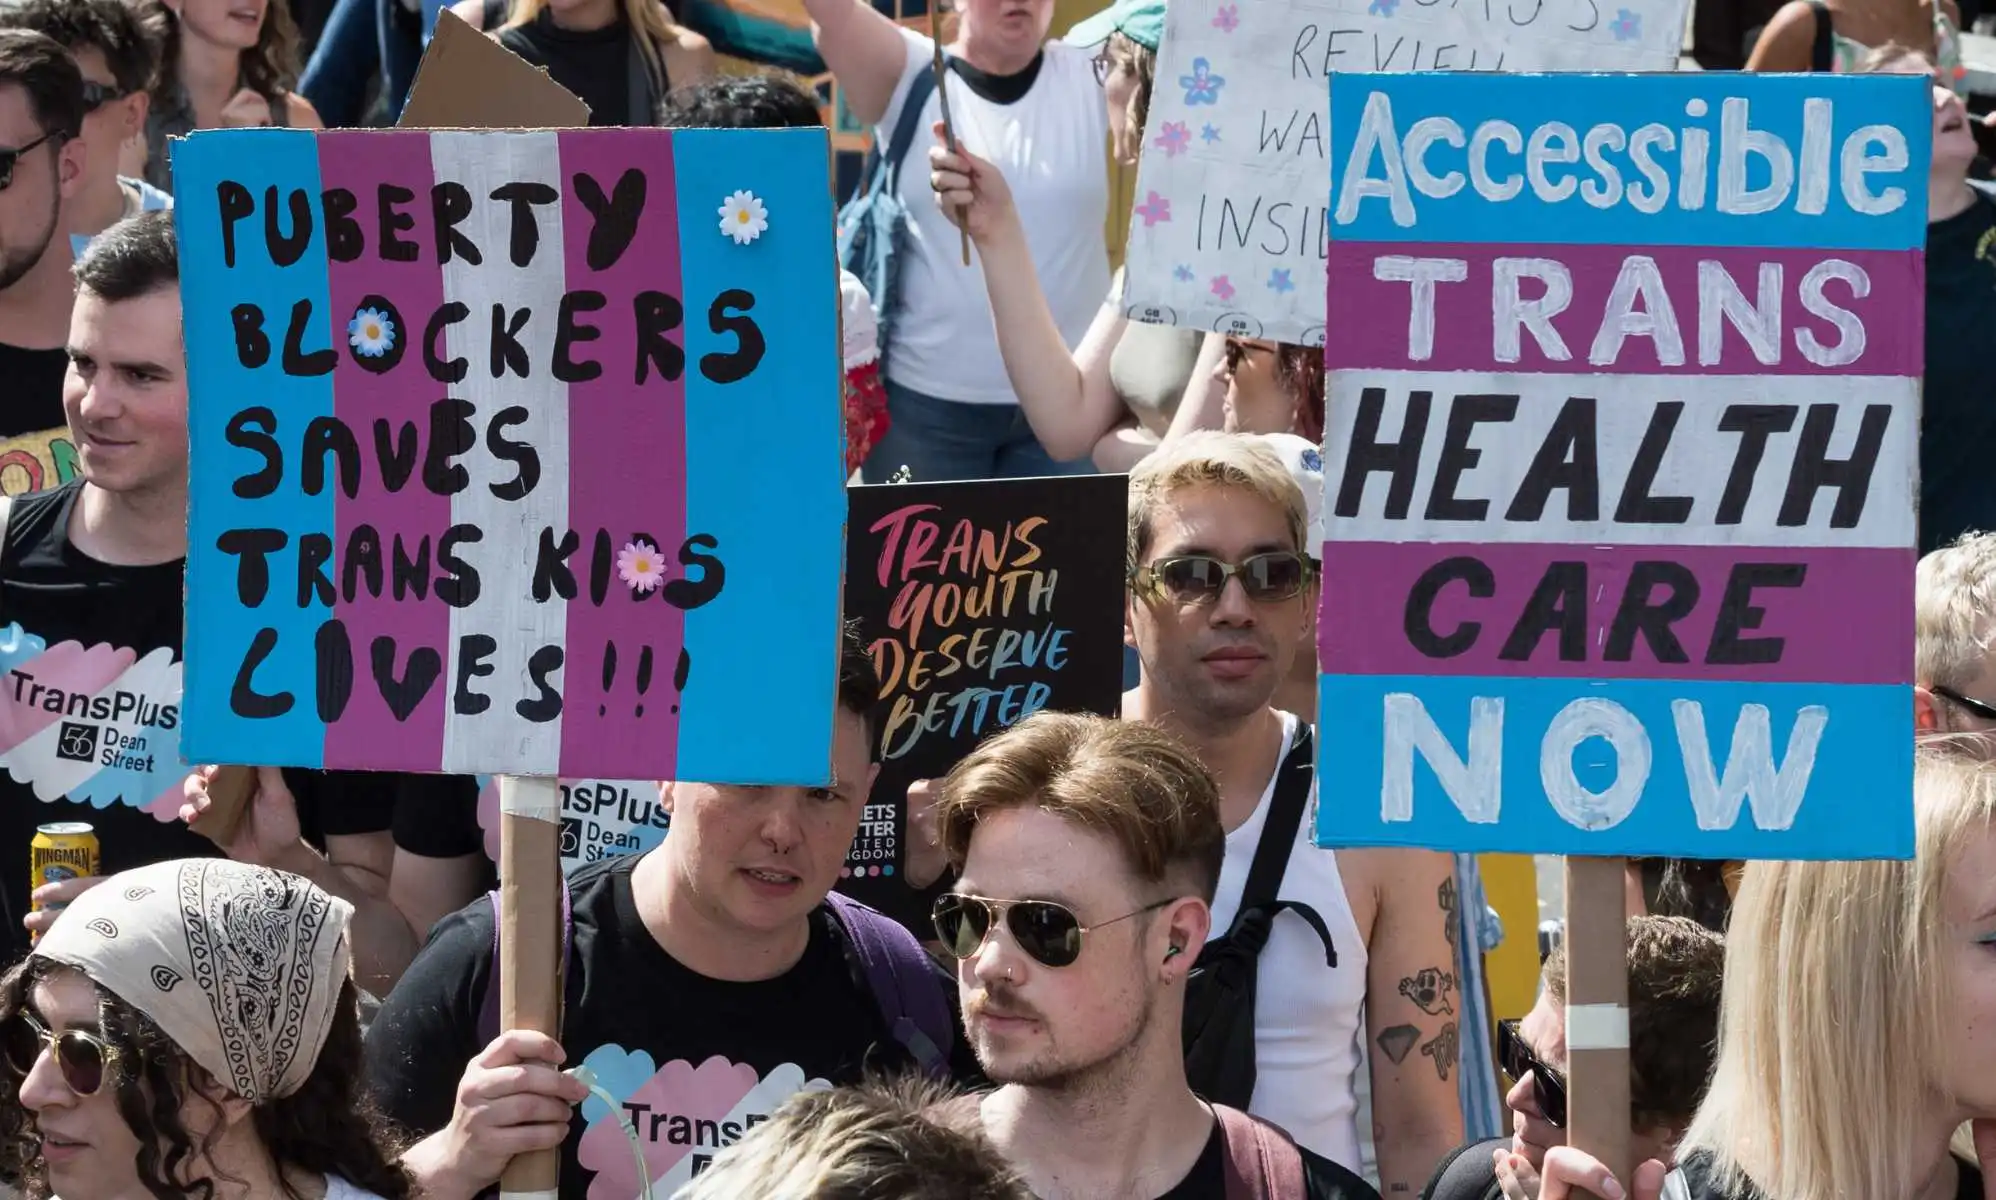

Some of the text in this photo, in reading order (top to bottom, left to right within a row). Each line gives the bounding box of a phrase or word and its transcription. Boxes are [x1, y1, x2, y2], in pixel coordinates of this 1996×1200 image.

[1335, 91, 1910, 228] Accessible
[217, 167, 647, 272] PUBERTY
[231, 289, 766, 386] BLOCKERS
[1373, 254, 1871, 367] TRANS
[225, 398, 541, 501] SAVES
[1334, 387, 1892, 530] HEALTH
[216, 523, 483, 609] TRANS
[867, 503, 1049, 589] TRANS
[887, 568, 1059, 650] YOUTH
[1403, 555, 1809, 666] CARE
[10, 668, 179, 730] TransPlus
[866, 621, 1075, 701] DESERVE
[60, 726, 94, 758] 56
[100, 748, 155, 774] Street
[104, 726, 147, 751] Dean
[1380, 692, 1830, 832] NOW
[587, 821, 640, 851] Dean
[855, 821, 896, 838] TER
[860, 804, 896, 821] ETS
